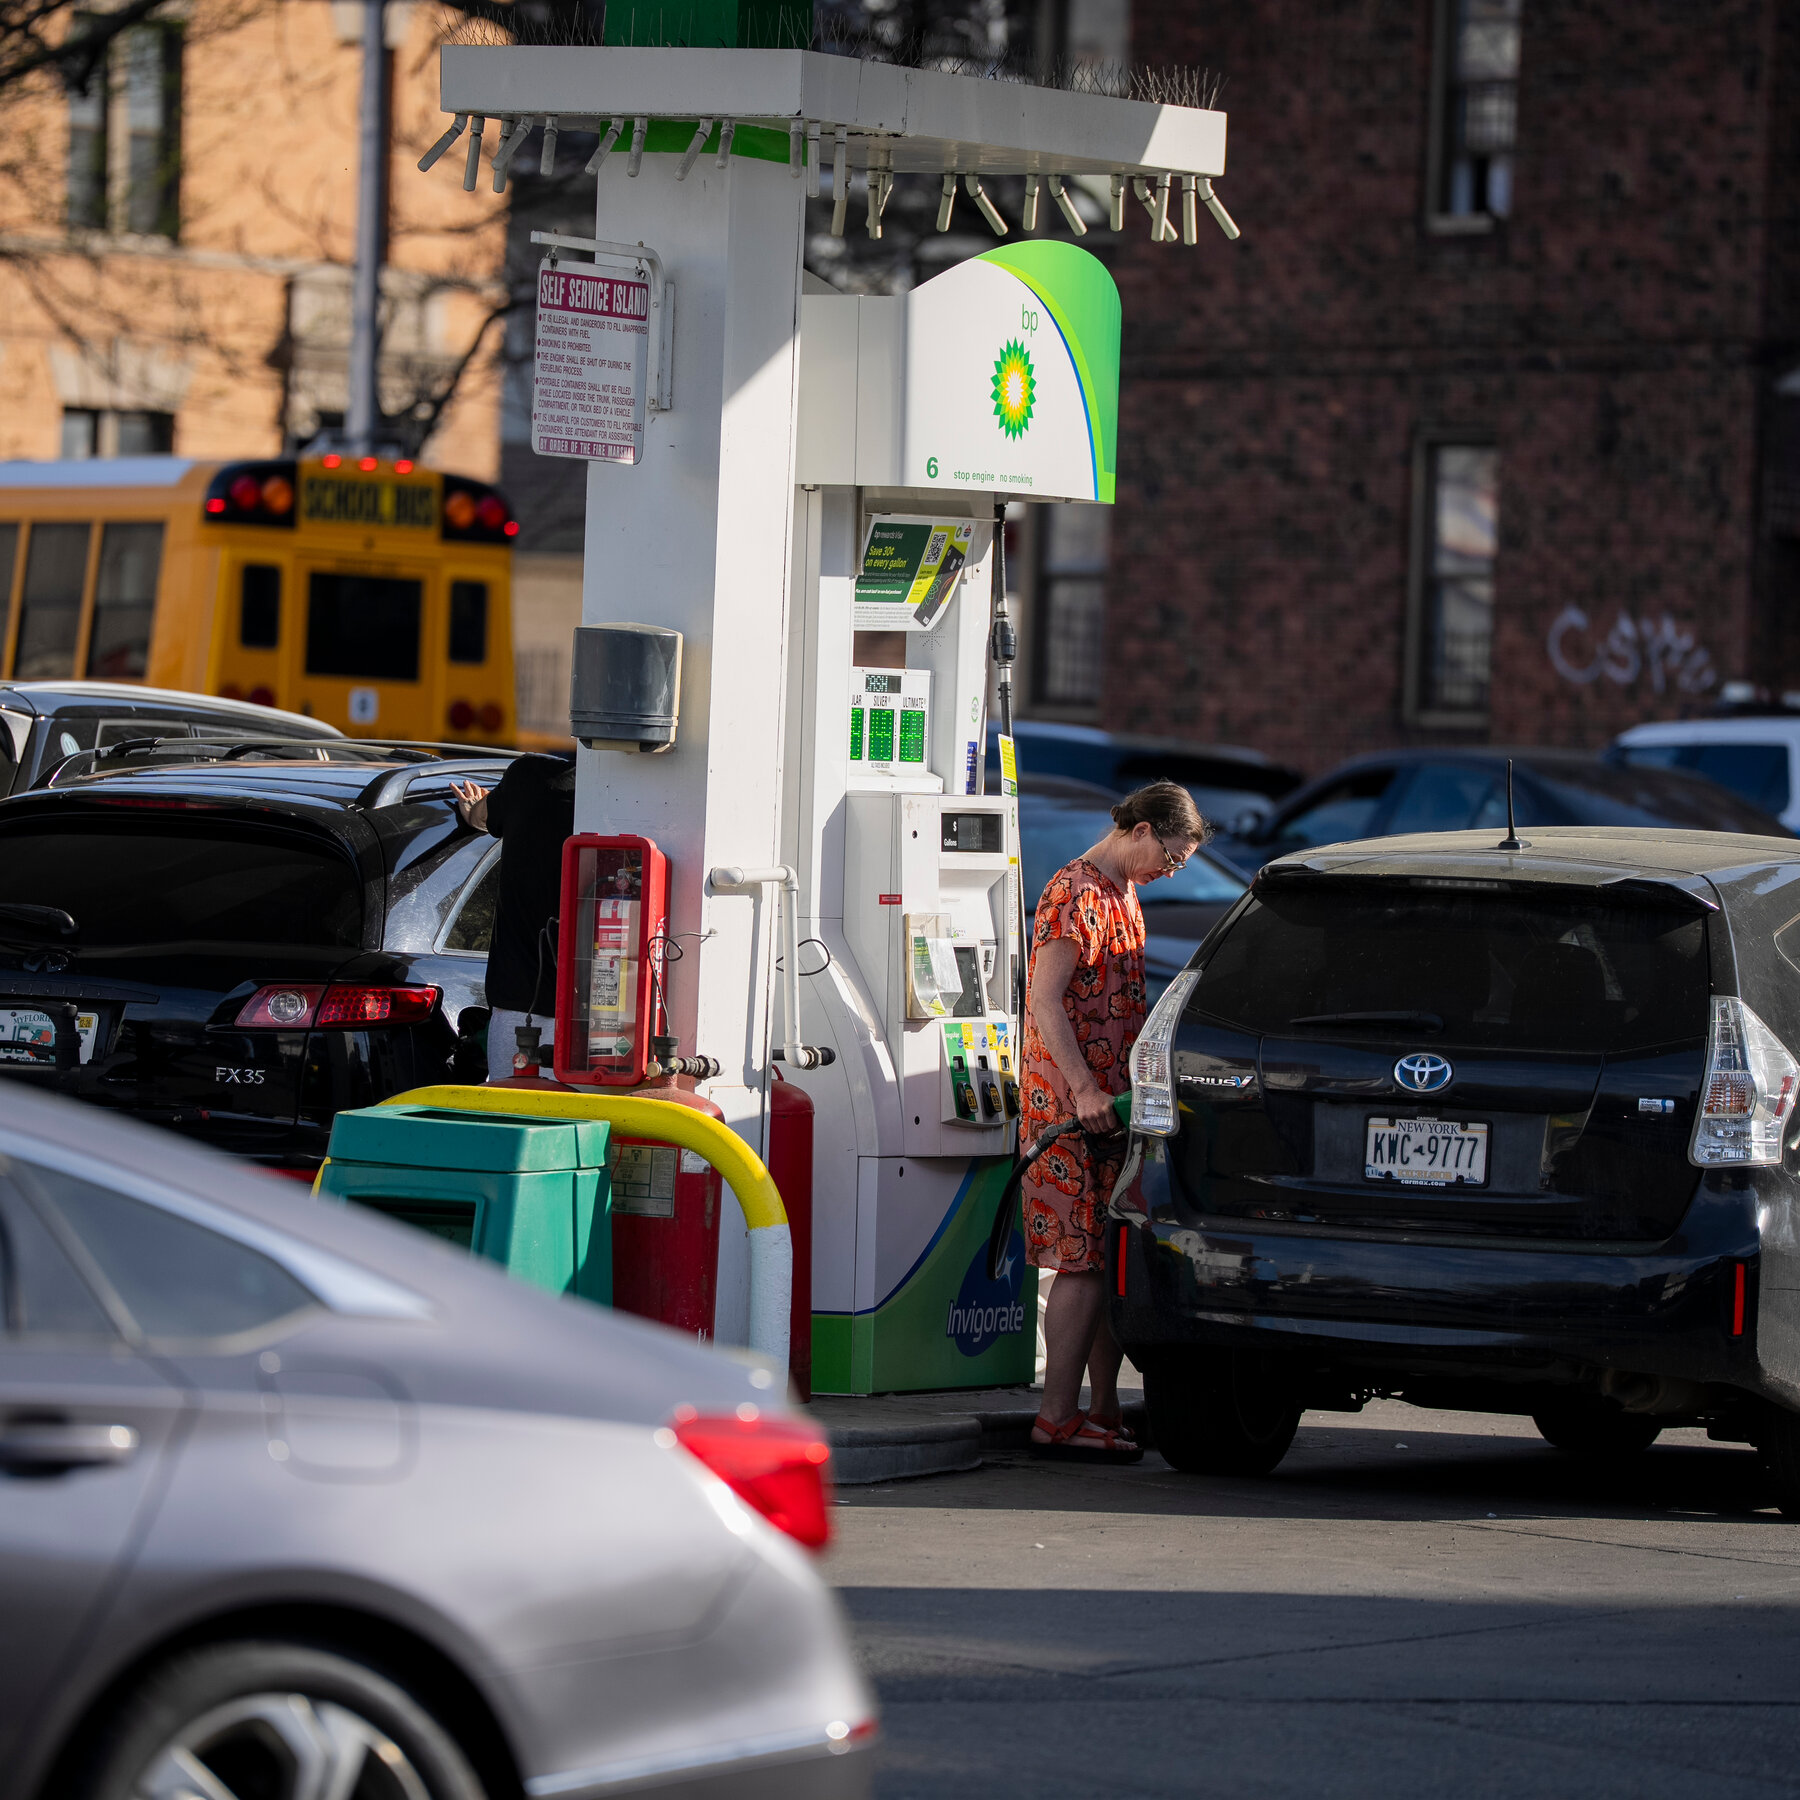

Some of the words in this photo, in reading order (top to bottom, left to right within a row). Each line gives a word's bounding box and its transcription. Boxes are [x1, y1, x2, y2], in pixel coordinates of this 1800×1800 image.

[541, 274, 566, 306] SELF
[568, 278, 609, 312] SERVICE
[612, 284, 648, 317] ISLAND
[542, 313, 547, 321] IT
[548, 314, 552, 322] IS
[553, 314, 569, 325] ILLEGAL
[570, 317, 579, 326] AND
[580, 318, 606, 330] DANGEROUS
[607, 321, 612, 330] TO
[613, 322, 621, 331] FILL
[623, 323, 647, 335] UNAPPROVED
[1022, 303, 1039, 337] bp
[542, 324, 567, 336] CONTAINERS
[569, 327, 578, 337] WITH
[541, 338, 560, 349] SMOKING
[562, 340, 566, 349] IS
[540, 362, 562, 374] REFUELING
[541, 351, 549, 361] THE
[550, 352, 565, 363] ENGINE
[566, 354, 579, 364] SHALL
[580, 356, 586, 366] BE
[587, 357, 597, 367] SHUT
[599, 358, 607, 368] OFF
[608, 360, 623, 370] DURING
[539, 377, 560, 388] PORTABLE
[561, 379, 586, 391] CONTAINERS
[588, 382, 600, 392] SHALL
[602, 384, 610, 393] NOT
[611, 385, 616, 394] BE
[618, 385, 632, 396] FILLED
[539, 387, 551, 398] WHILE
[552, 389, 571, 400] LOCATED
[572, 391, 586, 402] INSIDE
[587, 393, 595, 403] THE
[612, 396, 635, 407] PASSENGER
[571, 402, 577, 412] OR
[579, 403, 592, 413] TRUCK
[593, 405, 602, 415] BED
[603, 406, 609, 415] OF
[537, 412, 542, 421] IT
[543, 413, 547, 422] IS
[548, 414, 569, 425] UNLAWFUL
[571, 416, 579, 426] FOR
[580, 417, 606, 428] CUSTOMERS
[607, 420, 612, 430] TO
[613, 421, 621, 430] FILL
[623, 421, 642, 433] PORTABLE
[565, 426, 573, 436] SEE
[574, 428, 598, 439] ATTENDANT
[599, 430, 607, 440] FOR
[540, 438, 547, 450] BY
[549, 439, 569, 453] ORDER
[570, 441, 578, 453] OF
[580, 442, 591, 455] THE
[592, 443, 606, 456] FIRE
[926, 456, 939, 479] 6
[953, 470, 970, 482] stop
[971, 471, 995, 483] engine
[1000, 473, 1008, 482] no
[1008, 474, 1033, 486] smoking
[304, 478, 382, 523] SCHOOL
[393, 482, 434, 527] BUS
[869, 545, 883, 556] Save
[883, 546, 895, 556] 30¢
[865, 559, 874, 567] on
[873, 560, 889, 569] every
[952, 820, 958, 832] $
[943, 838, 958, 847] Gallons
[1398, 1121, 1424, 1134] NEW
[1428, 1123, 1460, 1136] YORK
[1400, 1179, 1446, 1187] carmax.com
[947, 1300, 1024, 1343] Invigorate
